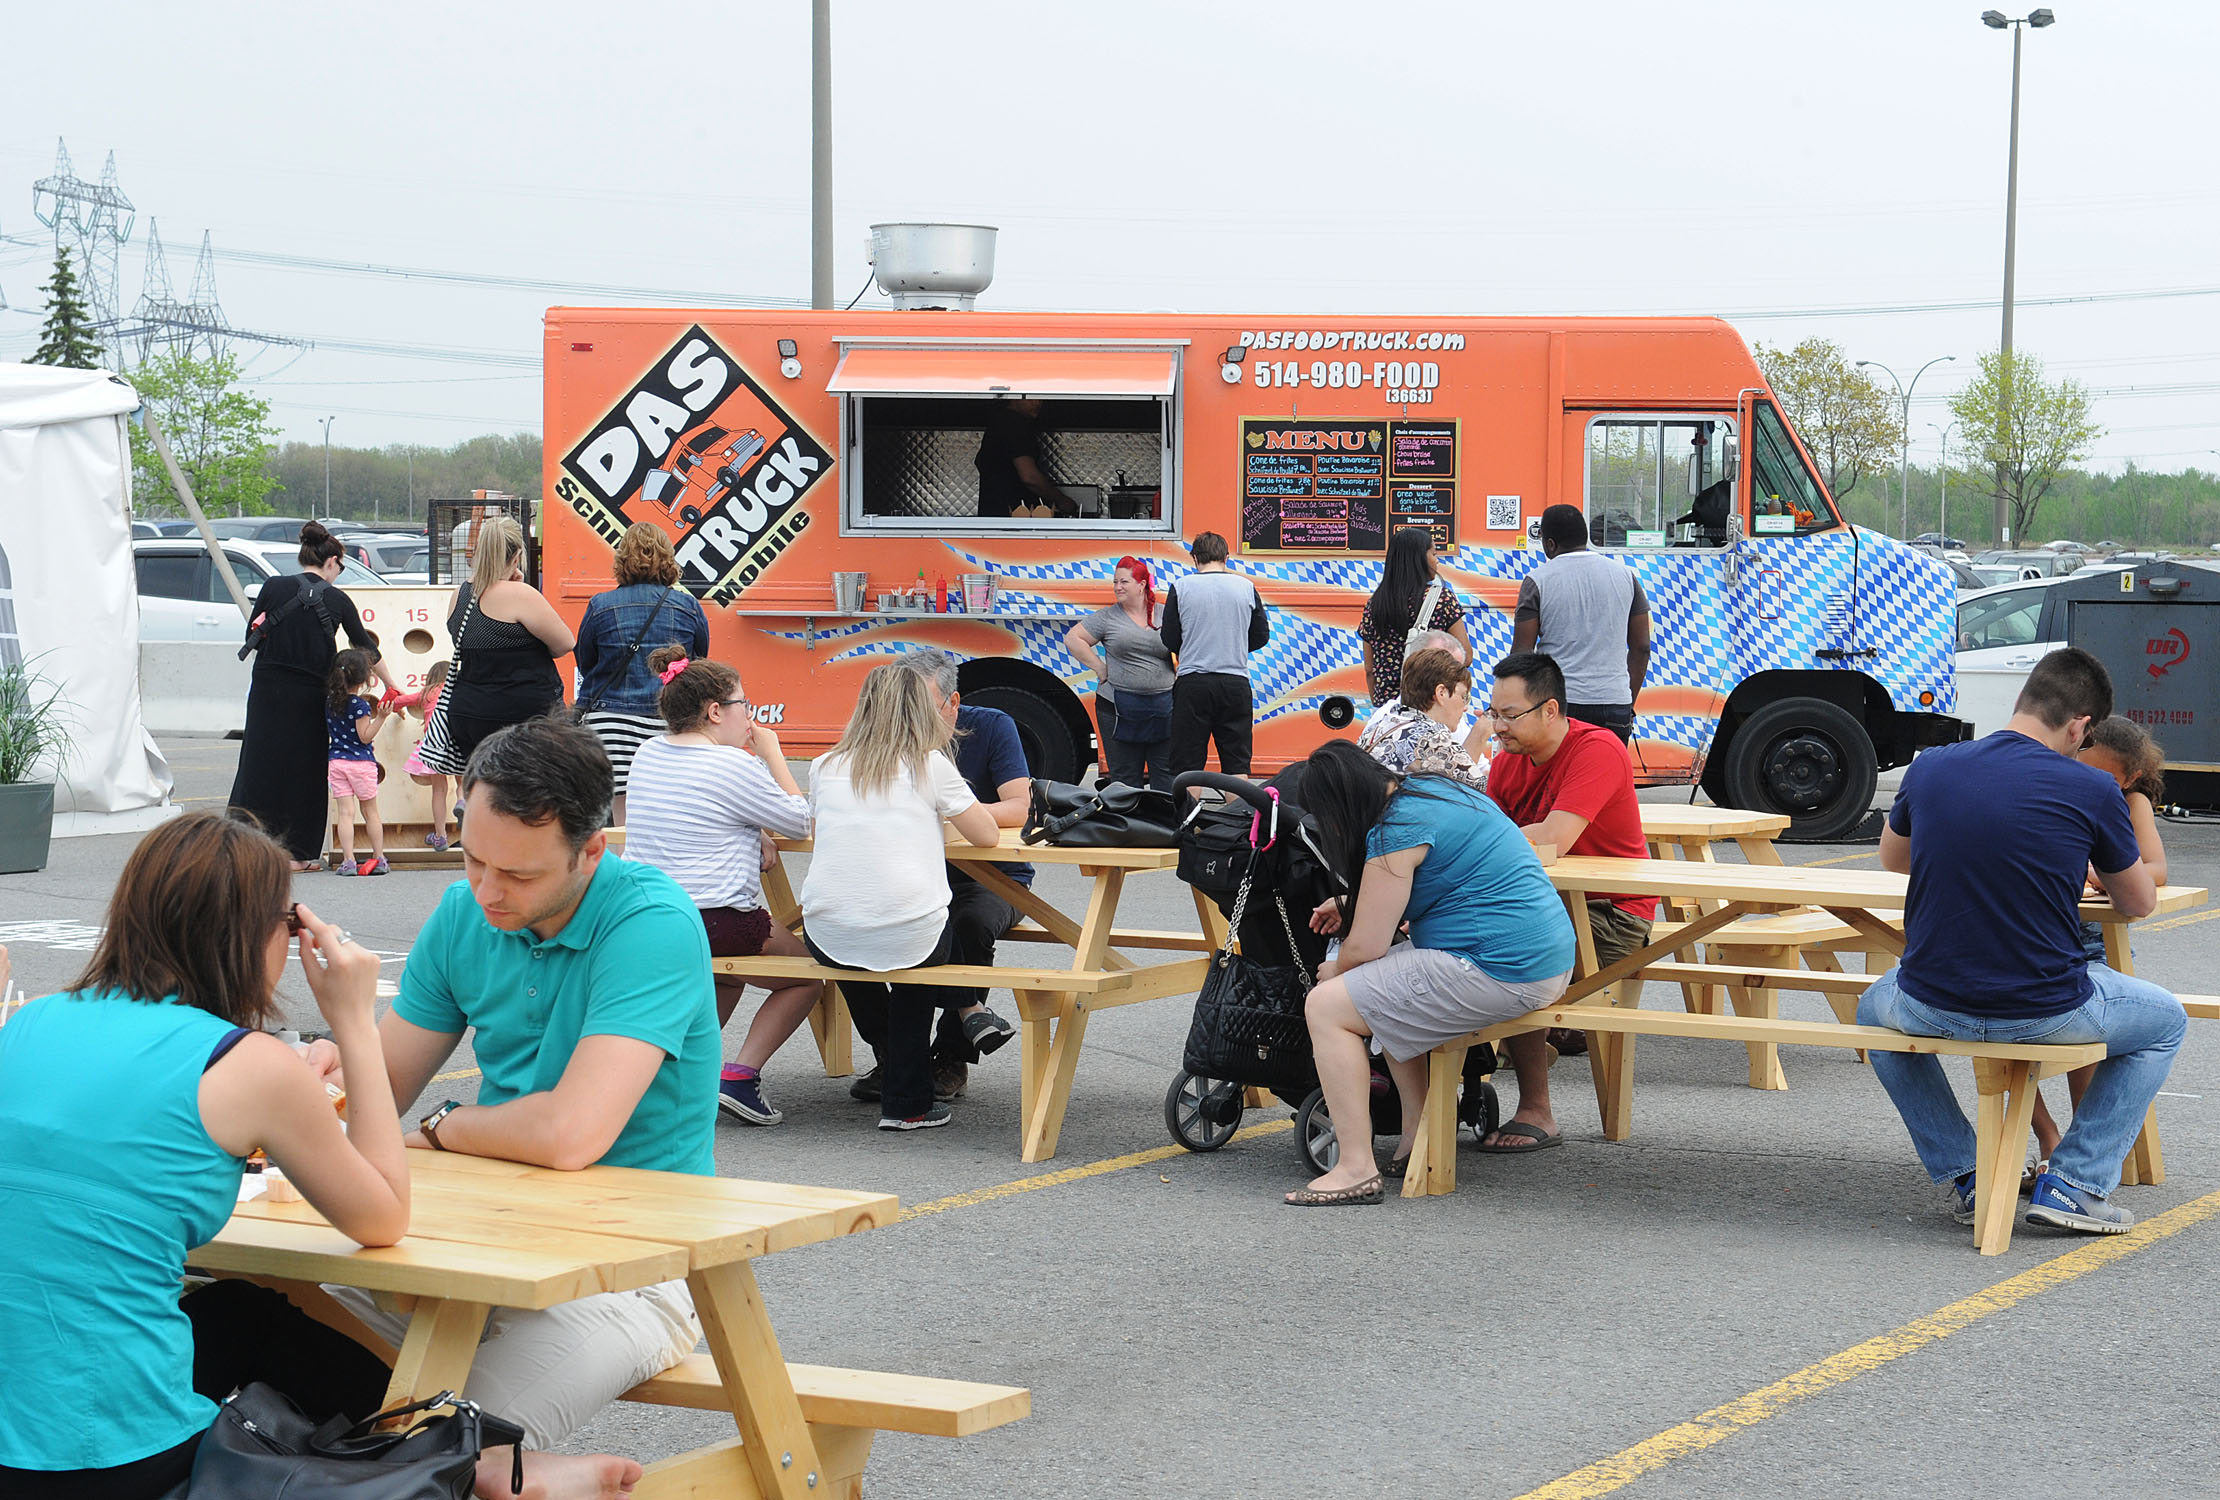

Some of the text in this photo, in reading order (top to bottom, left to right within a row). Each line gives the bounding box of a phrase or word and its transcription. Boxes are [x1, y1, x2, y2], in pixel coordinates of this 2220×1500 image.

[1254, 361, 1439, 389] 514-980-FOOD
[576, 338, 728, 498] DAS
[1265, 430, 1367, 450] MENU
[674, 437, 819, 582] TRUCK
[711, 511, 811, 608] Mobile
[405, 608, 429, 622] 15
[2050, 1187, 2079, 1212] Reebok
